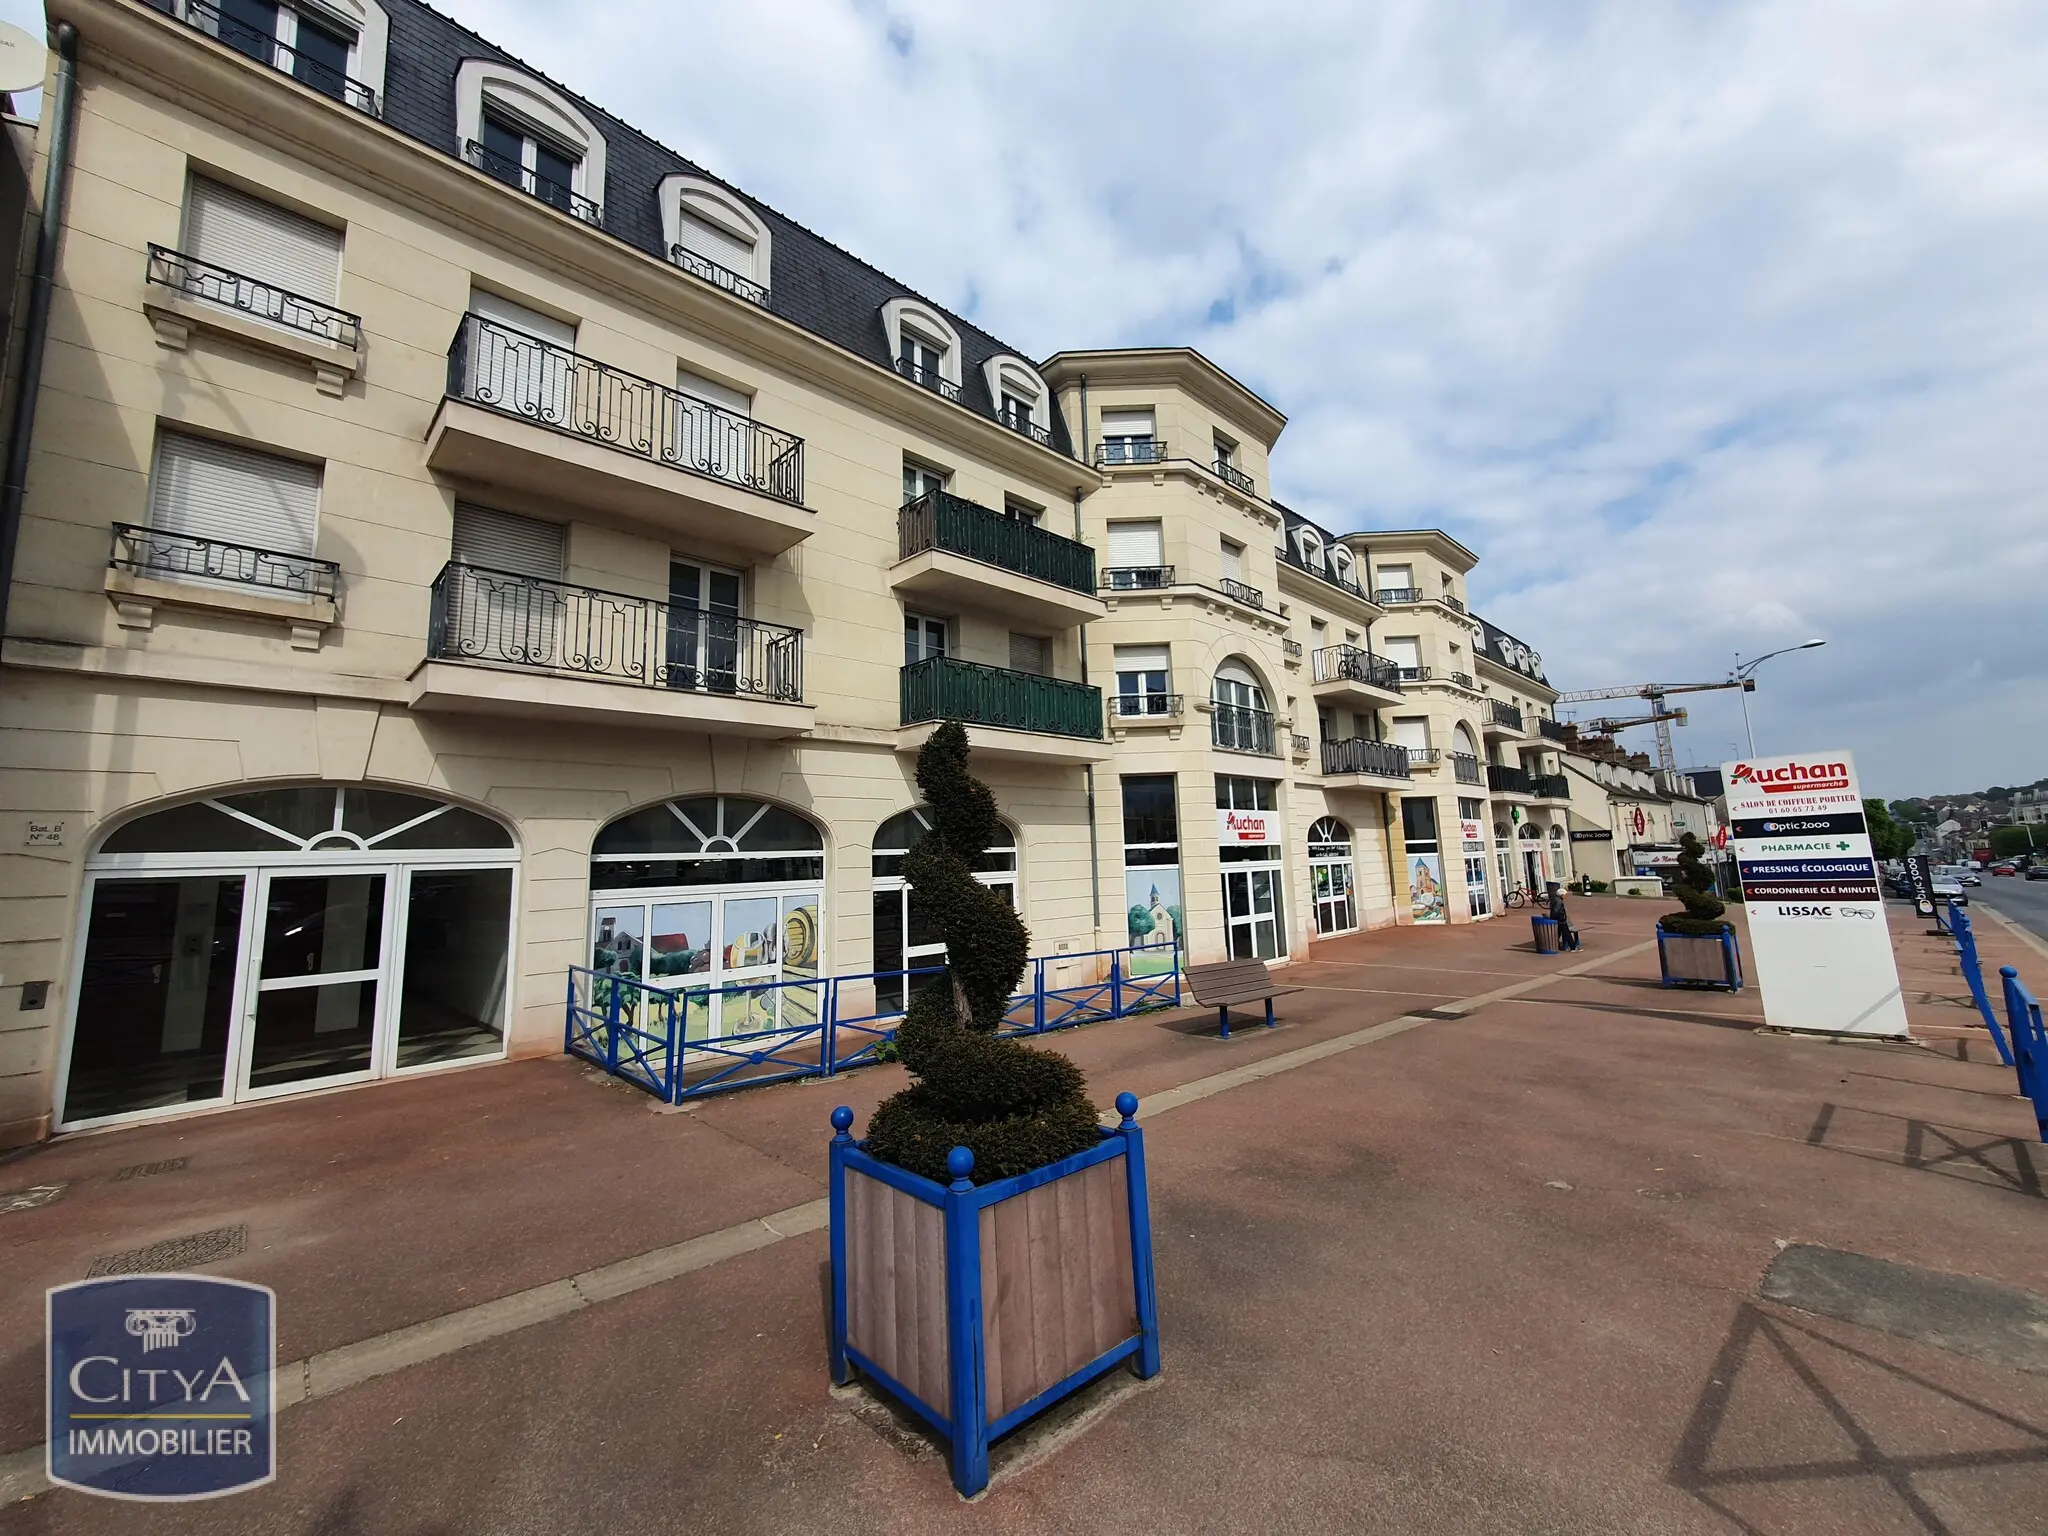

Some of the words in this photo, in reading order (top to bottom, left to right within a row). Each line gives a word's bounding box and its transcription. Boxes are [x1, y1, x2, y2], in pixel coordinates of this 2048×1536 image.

[1730, 762, 1847, 785] Auchan
[1792, 780, 1844, 791] supermarché
[1740, 800, 1764, 809] SALON
[1766, 799, 1777, 807] DE
[1778, 796, 1818, 806] COIFFURE
[1820, 794, 1857, 804] PORTIER
[1817, 804, 1827, 812] 49
[1226, 811, 1265, 830] Auchan
[1769, 822, 1800, 832] Optic
[1800, 821, 1830, 829] 2000
[1761, 842, 1831, 852] PHARMACIE
[1752, 865, 1799, 874] PRESSING
[1801, 863, 1870, 873] ÉCOLOGIQUE
[1754, 887, 1819, 895] CORDONNERIE
[1820, 885, 1837, 894] CLÉ
[1838, 886, 1878, 894] MINUTE
[1778, 906, 1832, 916] LISSAC
